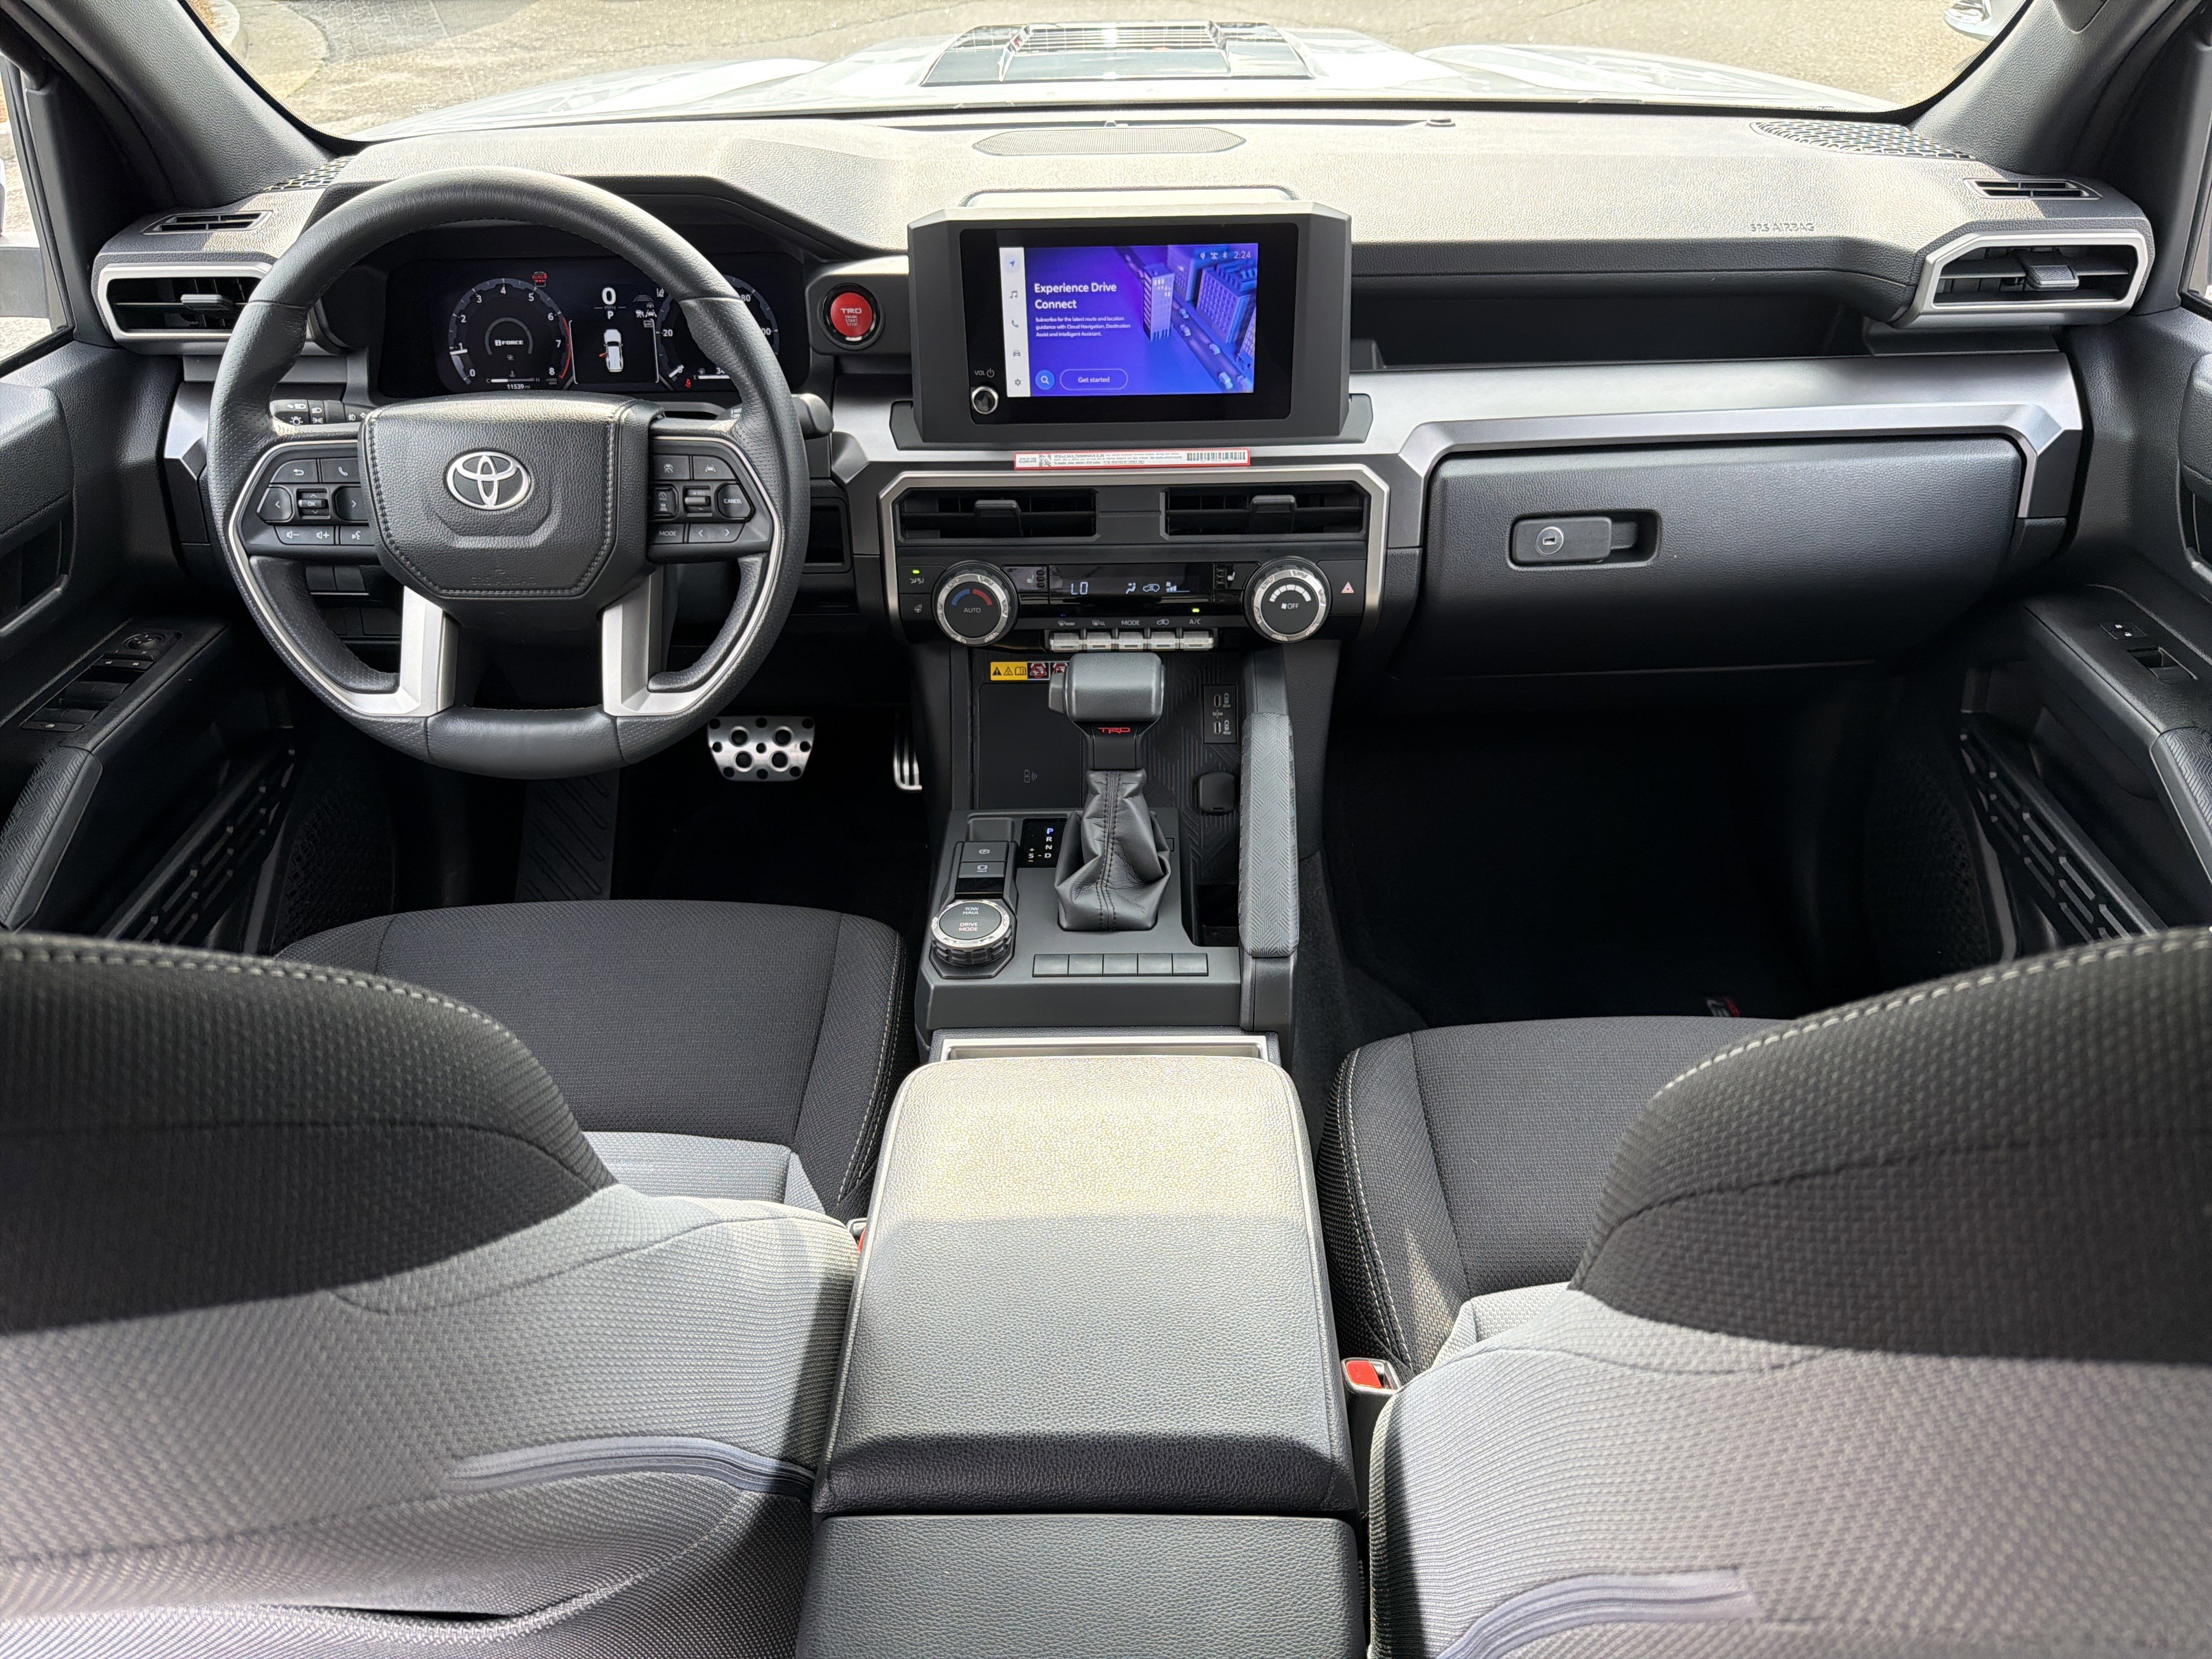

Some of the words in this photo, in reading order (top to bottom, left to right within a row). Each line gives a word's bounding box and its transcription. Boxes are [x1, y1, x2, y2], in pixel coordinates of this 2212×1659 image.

[1034, 283, 1089, 295] Experience
[1091, 281, 1117, 292] Drive
[528, 293, 534, 301] 5
[602, 287, 616, 305] 0
[1035, 299, 1077, 309] Connect
[461, 315, 466, 323] 2
[548, 313, 554, 321] 6
[607, 311, 614, 320] P
[556, 340, 561, 348] 7
[549, 367, 555, 375] 8
